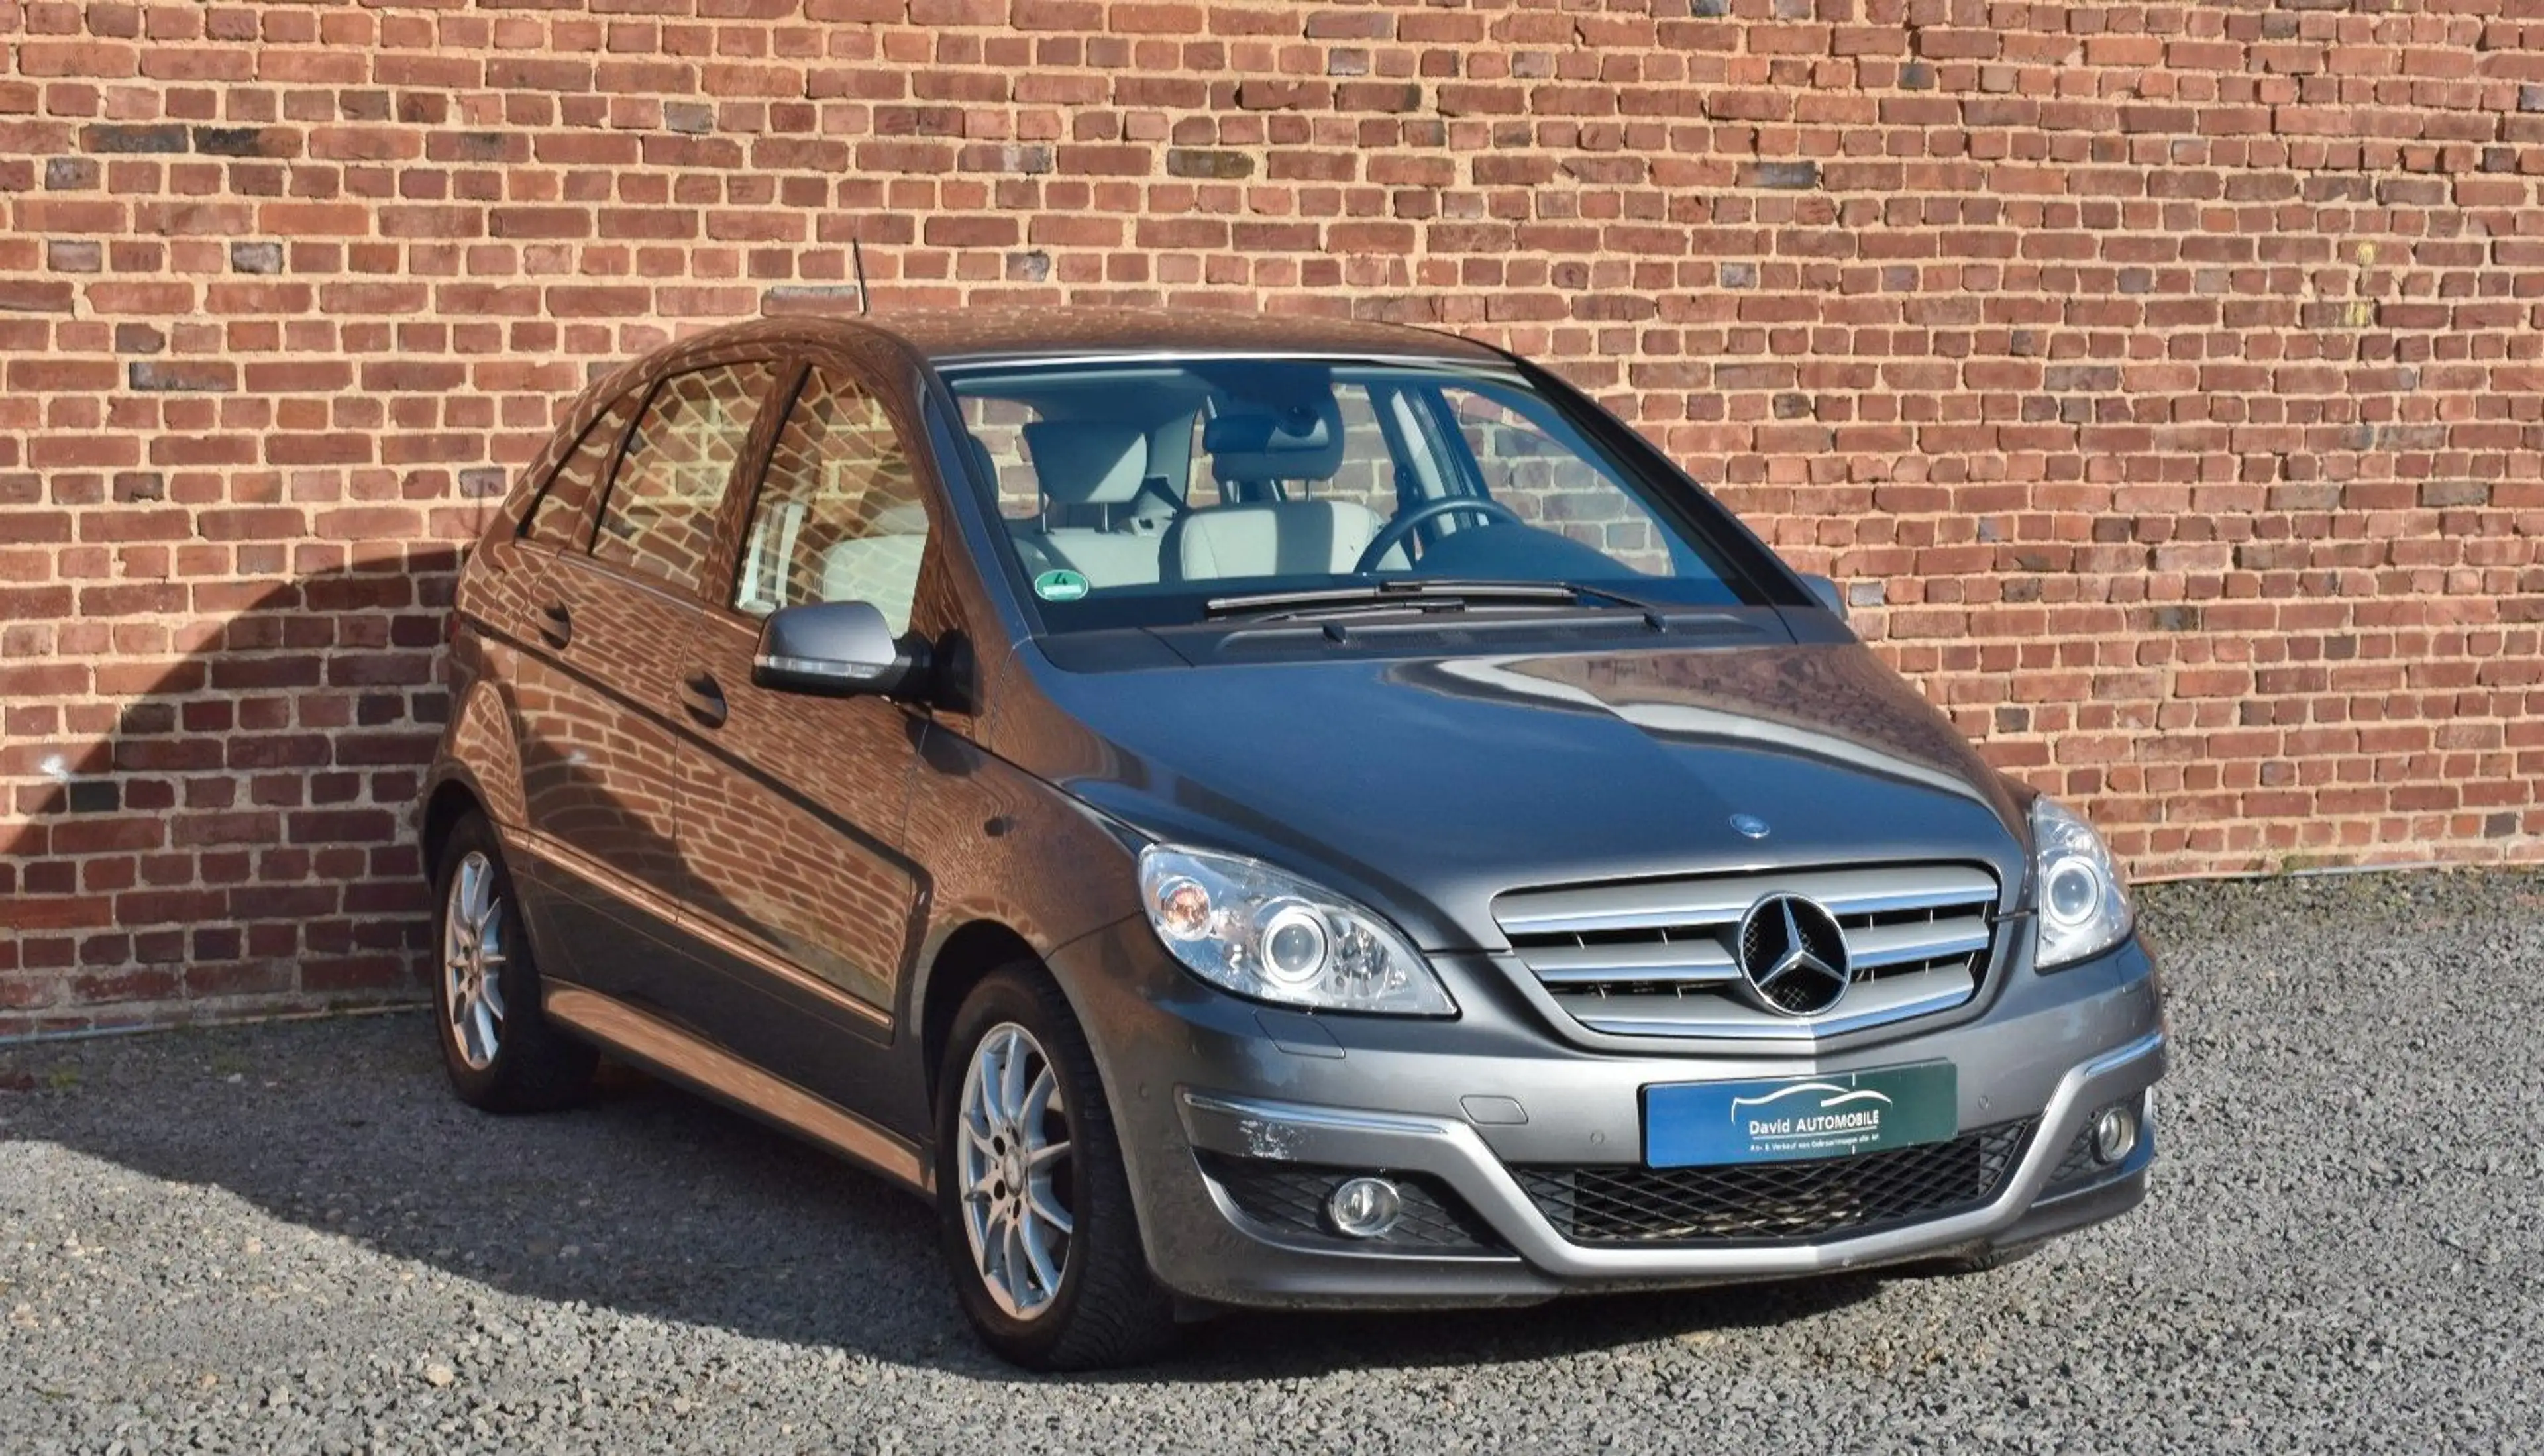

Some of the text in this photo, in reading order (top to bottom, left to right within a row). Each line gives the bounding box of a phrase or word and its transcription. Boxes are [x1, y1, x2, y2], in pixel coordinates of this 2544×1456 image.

[1054, 572, 1068, 586] 4
[1750, 1109, 1879, 1135] David AUTOMOBILE
